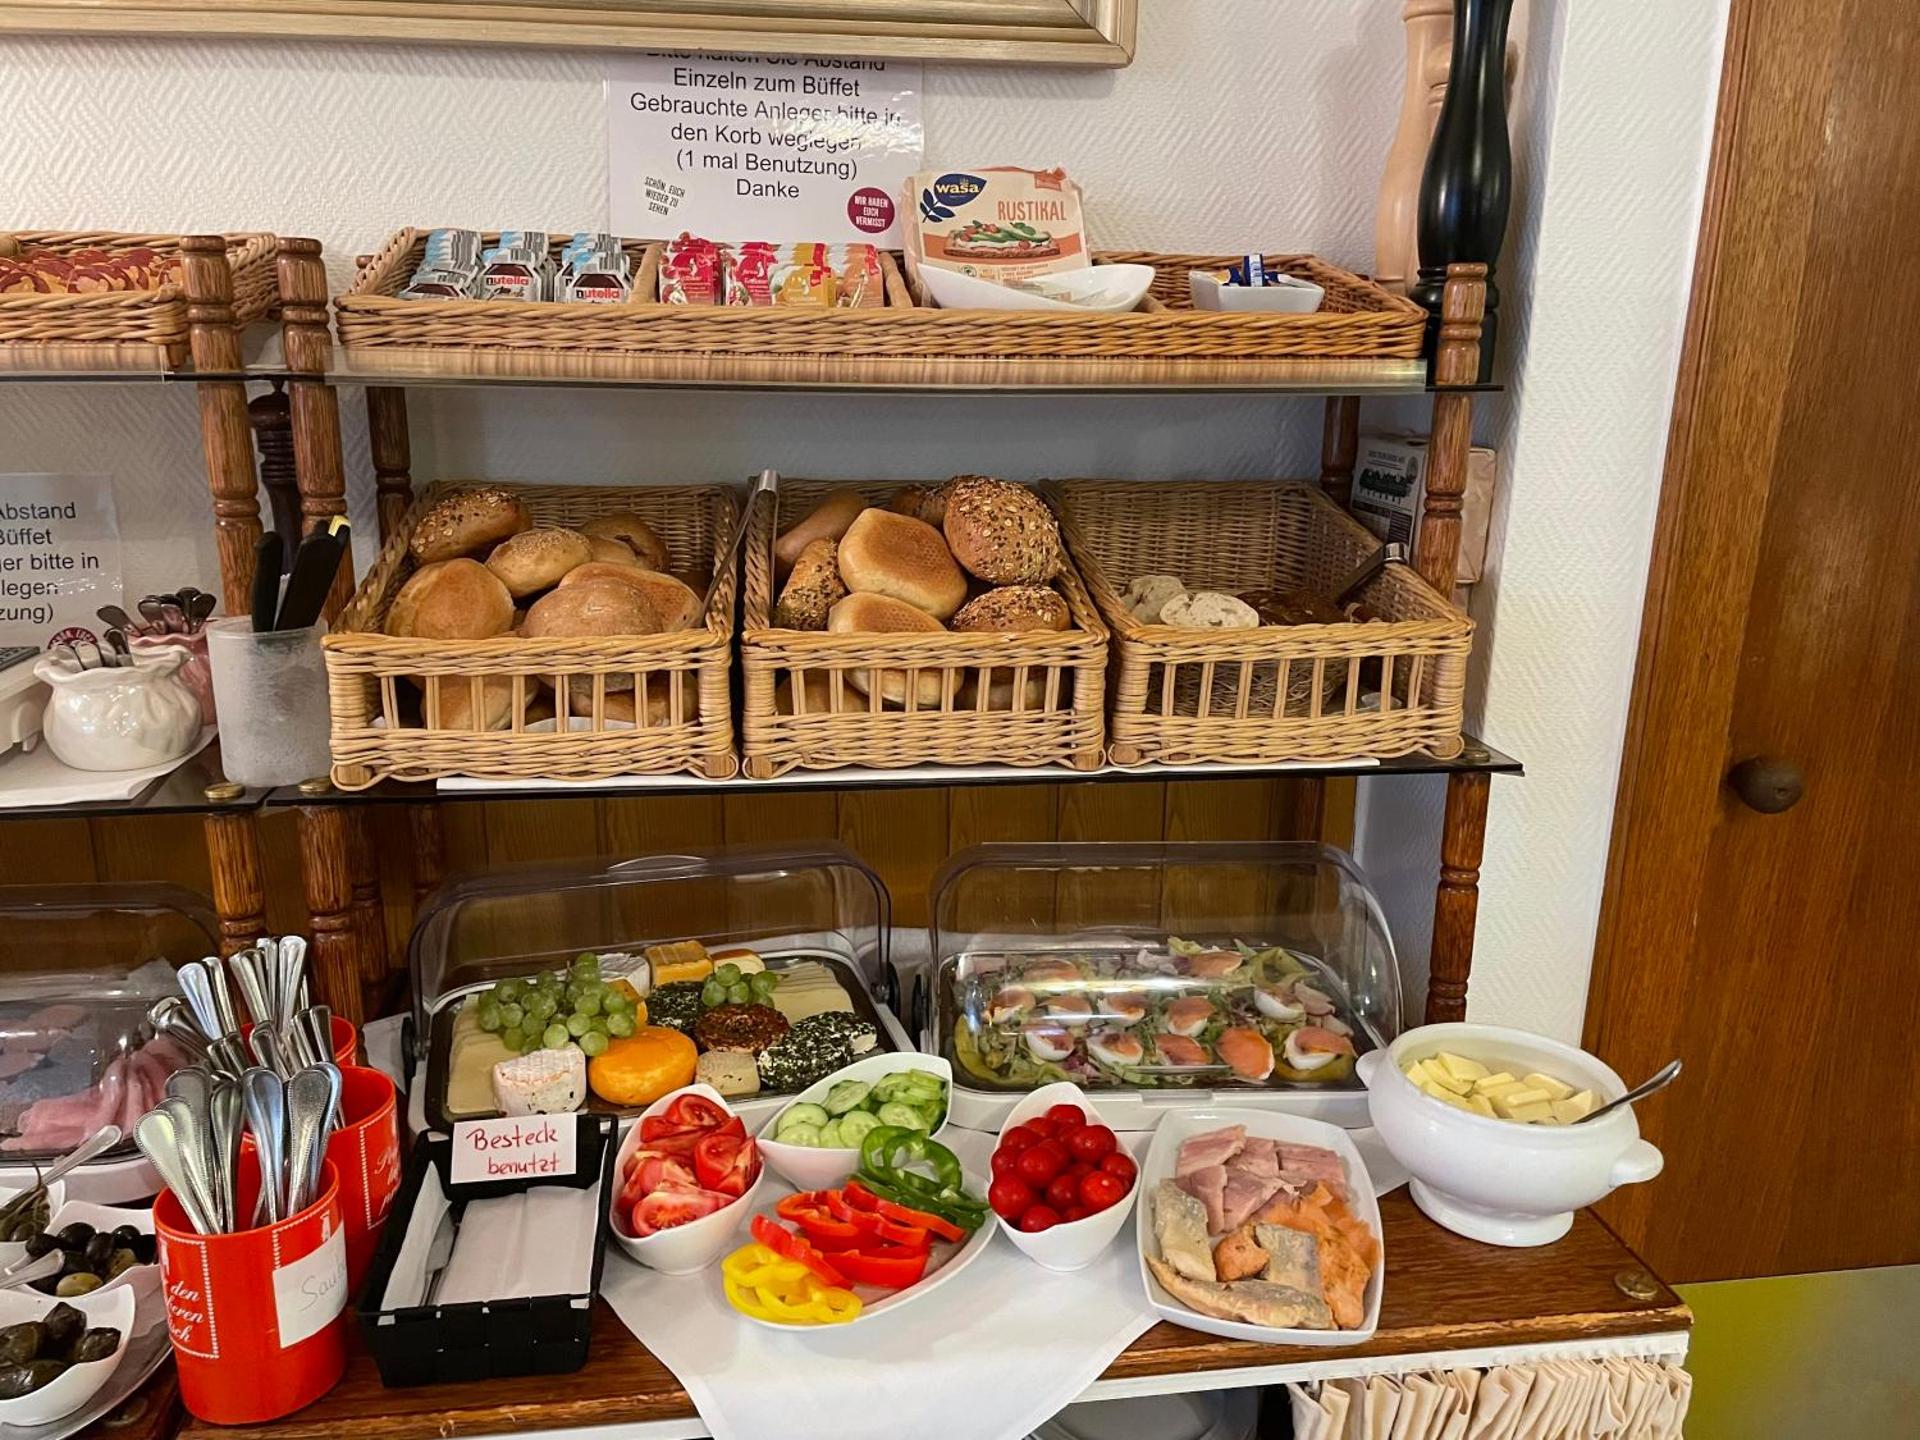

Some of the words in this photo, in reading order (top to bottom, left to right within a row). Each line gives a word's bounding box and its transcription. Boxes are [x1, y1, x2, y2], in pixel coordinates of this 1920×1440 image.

[673, 67, 747, 89] Einzeln
[753, 76, 795, 93] zum
[803, 75, 860, 97] Büffet
[630, 92, 748, 118] Gebrauchte
[671, 123, 708, 141] den
[715, 124, 761, 145] Korb
[676, 148, 693, 171] (1
[703, 152, 738, 170] mal
[745, 153, 858, 181] Benutzung)
[736, 178, 799, 199] Danke
[935, 182, 980, 195] wasa
[996, 200, 1068, 221] RUSTIKAL
[485, 276, 529, 287] nutella
[575, 288, 620, 299] nutella
[30, 552, 75, 570] bitte
[81, 552, 100, 569] in
[465, 1120, 559, 1151] Besteck
[487, 1151, 561, 1175] benutzt
[169, 1280, 201, 1302] den
